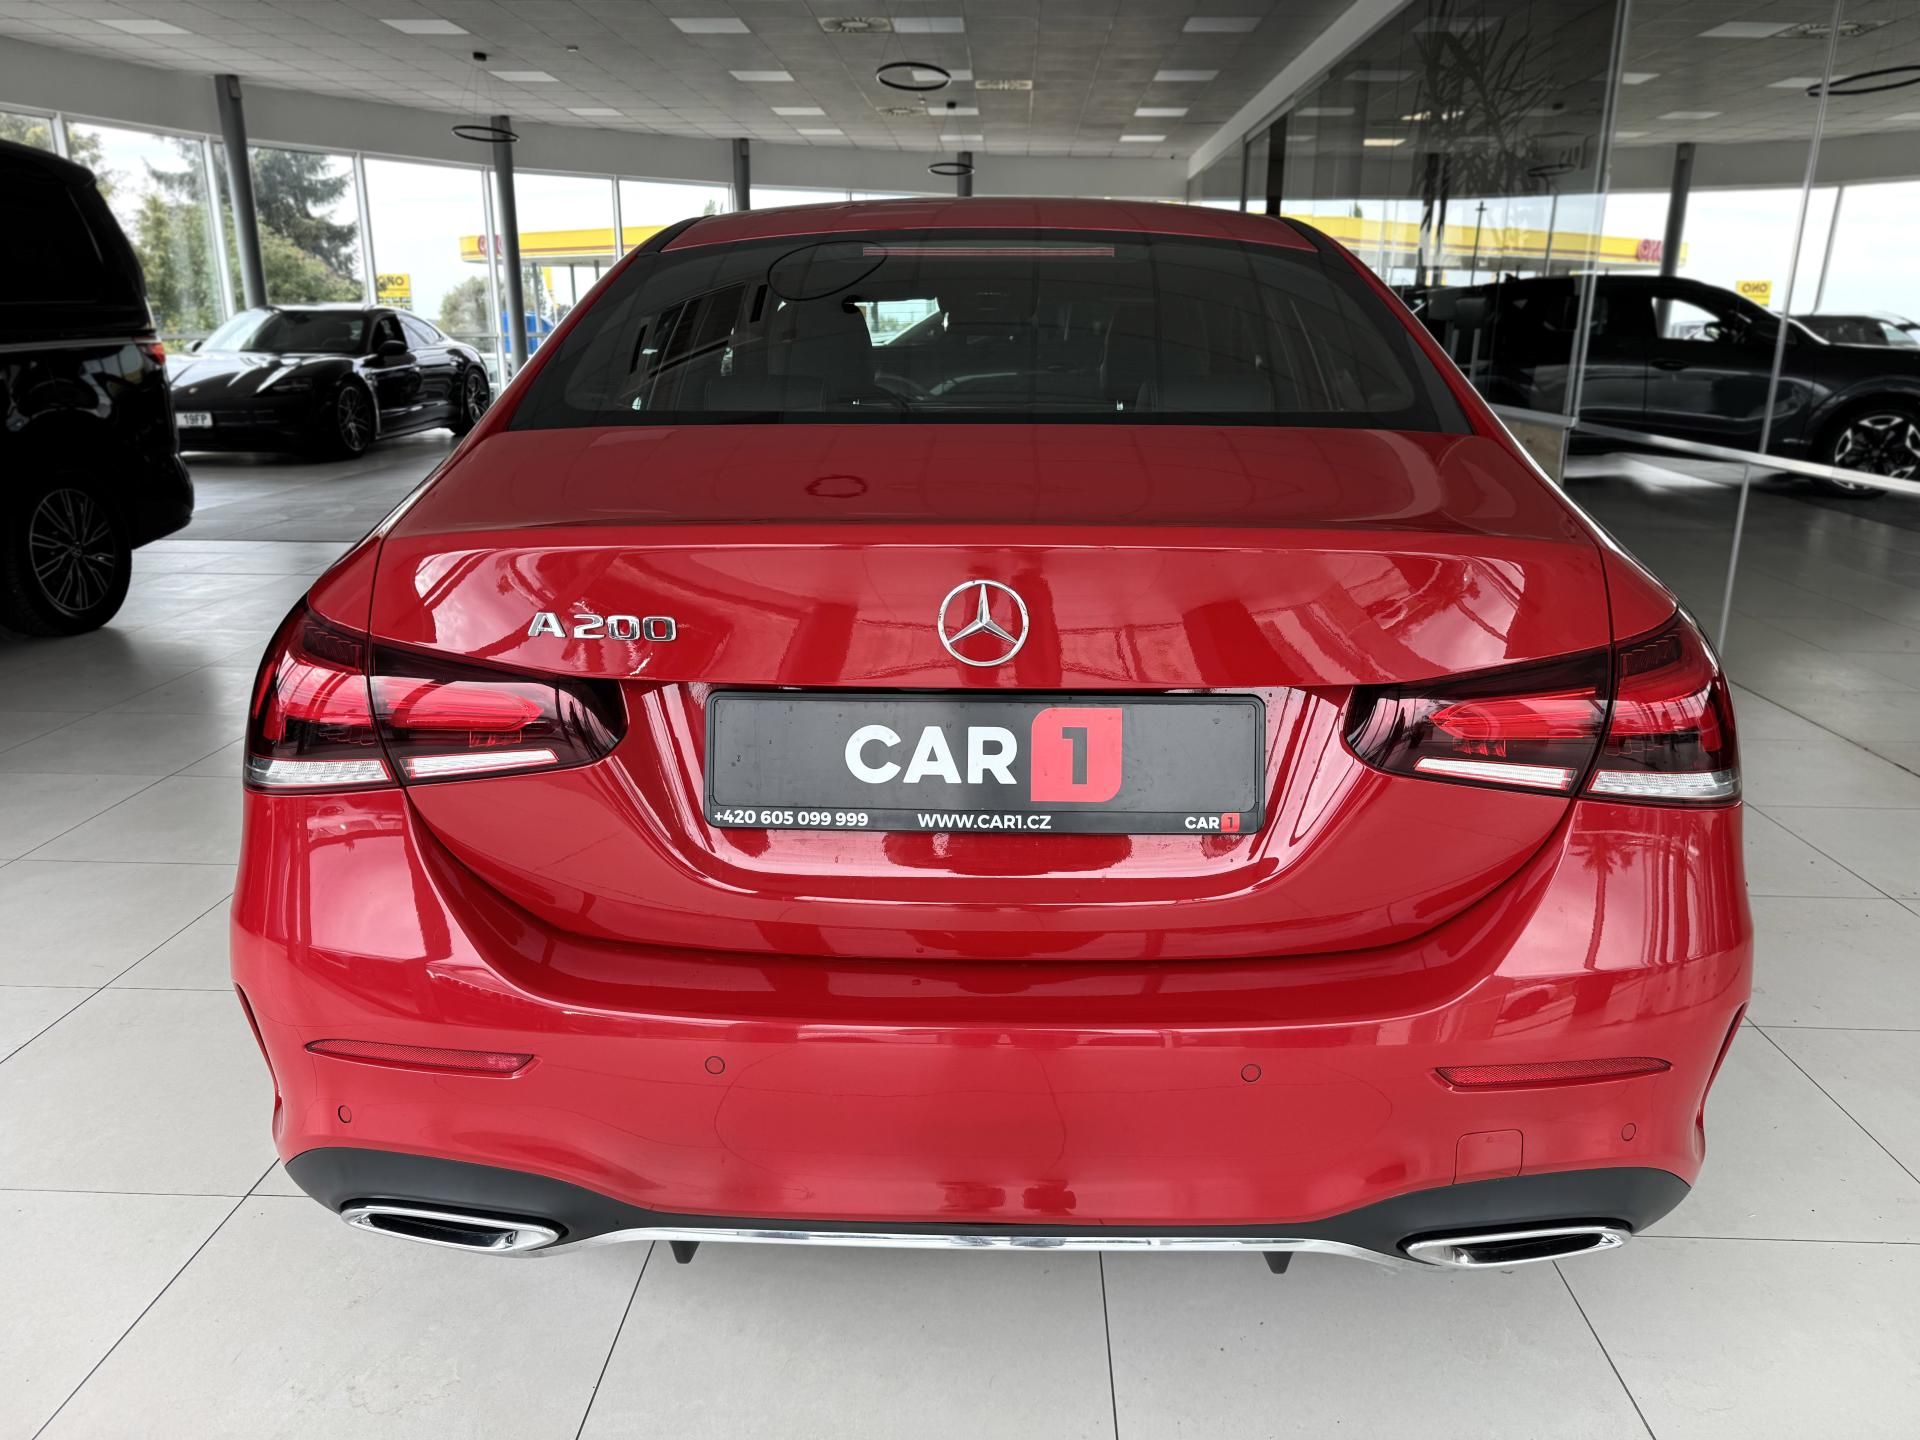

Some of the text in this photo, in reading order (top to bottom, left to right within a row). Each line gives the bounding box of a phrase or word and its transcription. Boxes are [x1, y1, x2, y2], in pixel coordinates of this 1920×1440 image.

[527, 612, 677, 642] A 200
[714, 809, 869, 827] +420 605 099 999
[917, 813, 1052, 829] WWW.CAR1.CZ
